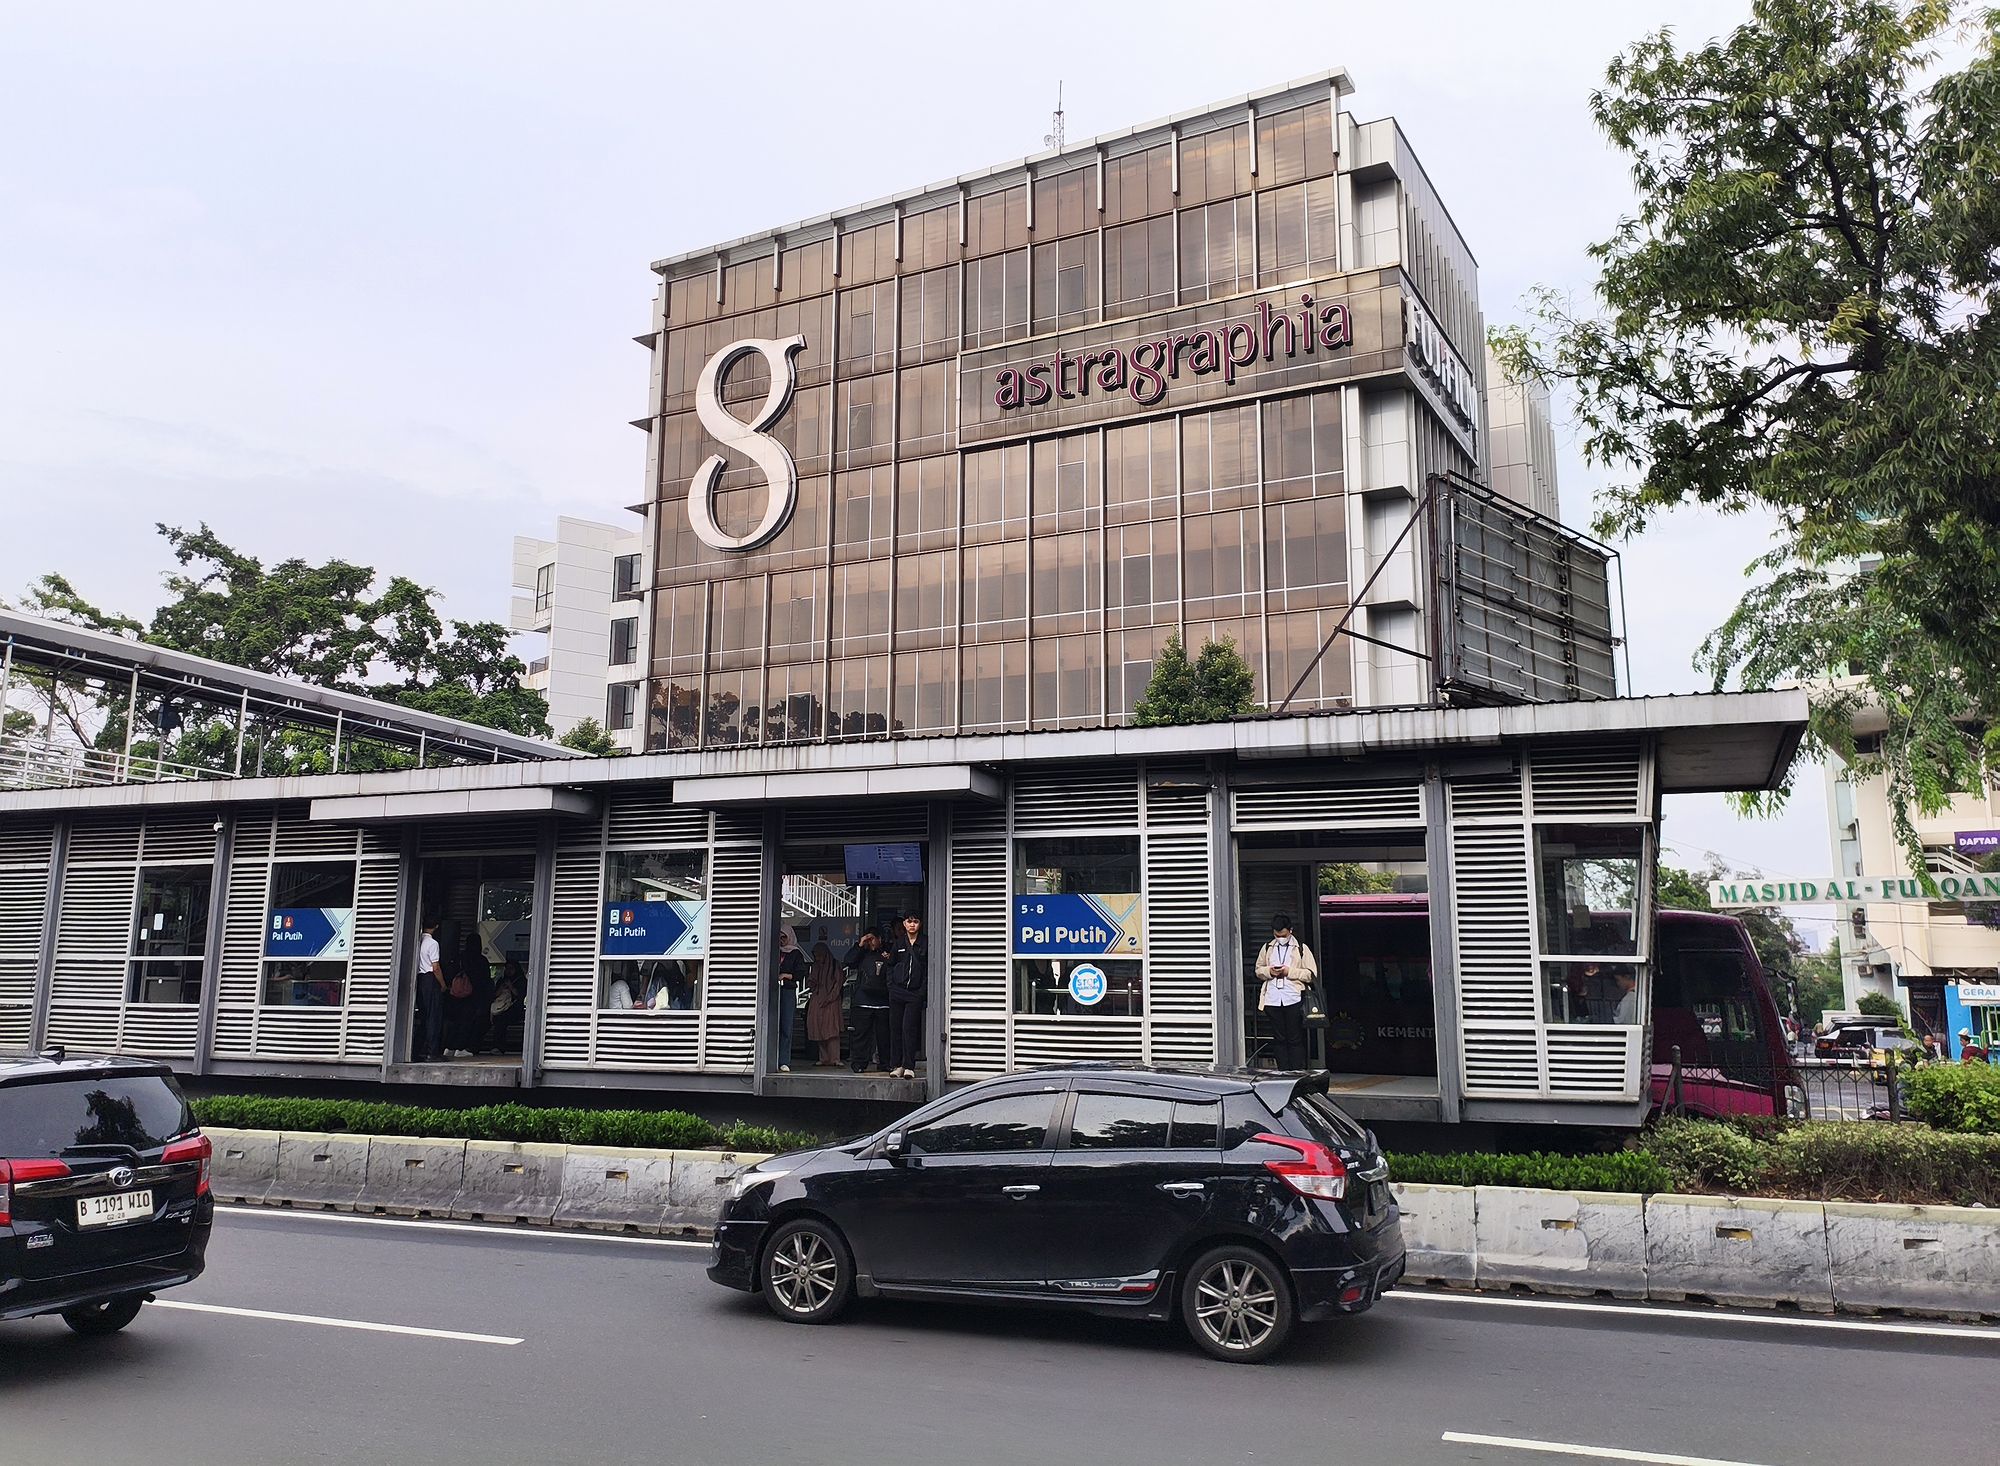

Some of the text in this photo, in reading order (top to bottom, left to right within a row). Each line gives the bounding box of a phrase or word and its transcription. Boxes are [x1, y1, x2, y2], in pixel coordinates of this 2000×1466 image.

[994, 293, 1353, 406] astragraphia
[1959, 837, 1998, 846] DAFTAR
[1719, 882, 1817, 903] MASJID
[1881, 877, 2000, 900] FUQAN
[272, 931, 303, 941] Pal Putih
[609, 927, 646, 937] Pal Putih
[1021, 926, 1106, 943] Pal Putih
[1963, 988, 1996, 996] GERAI
[80, 1201, 88, 1217] B
[95, 1196, 123, 1214] 1191
